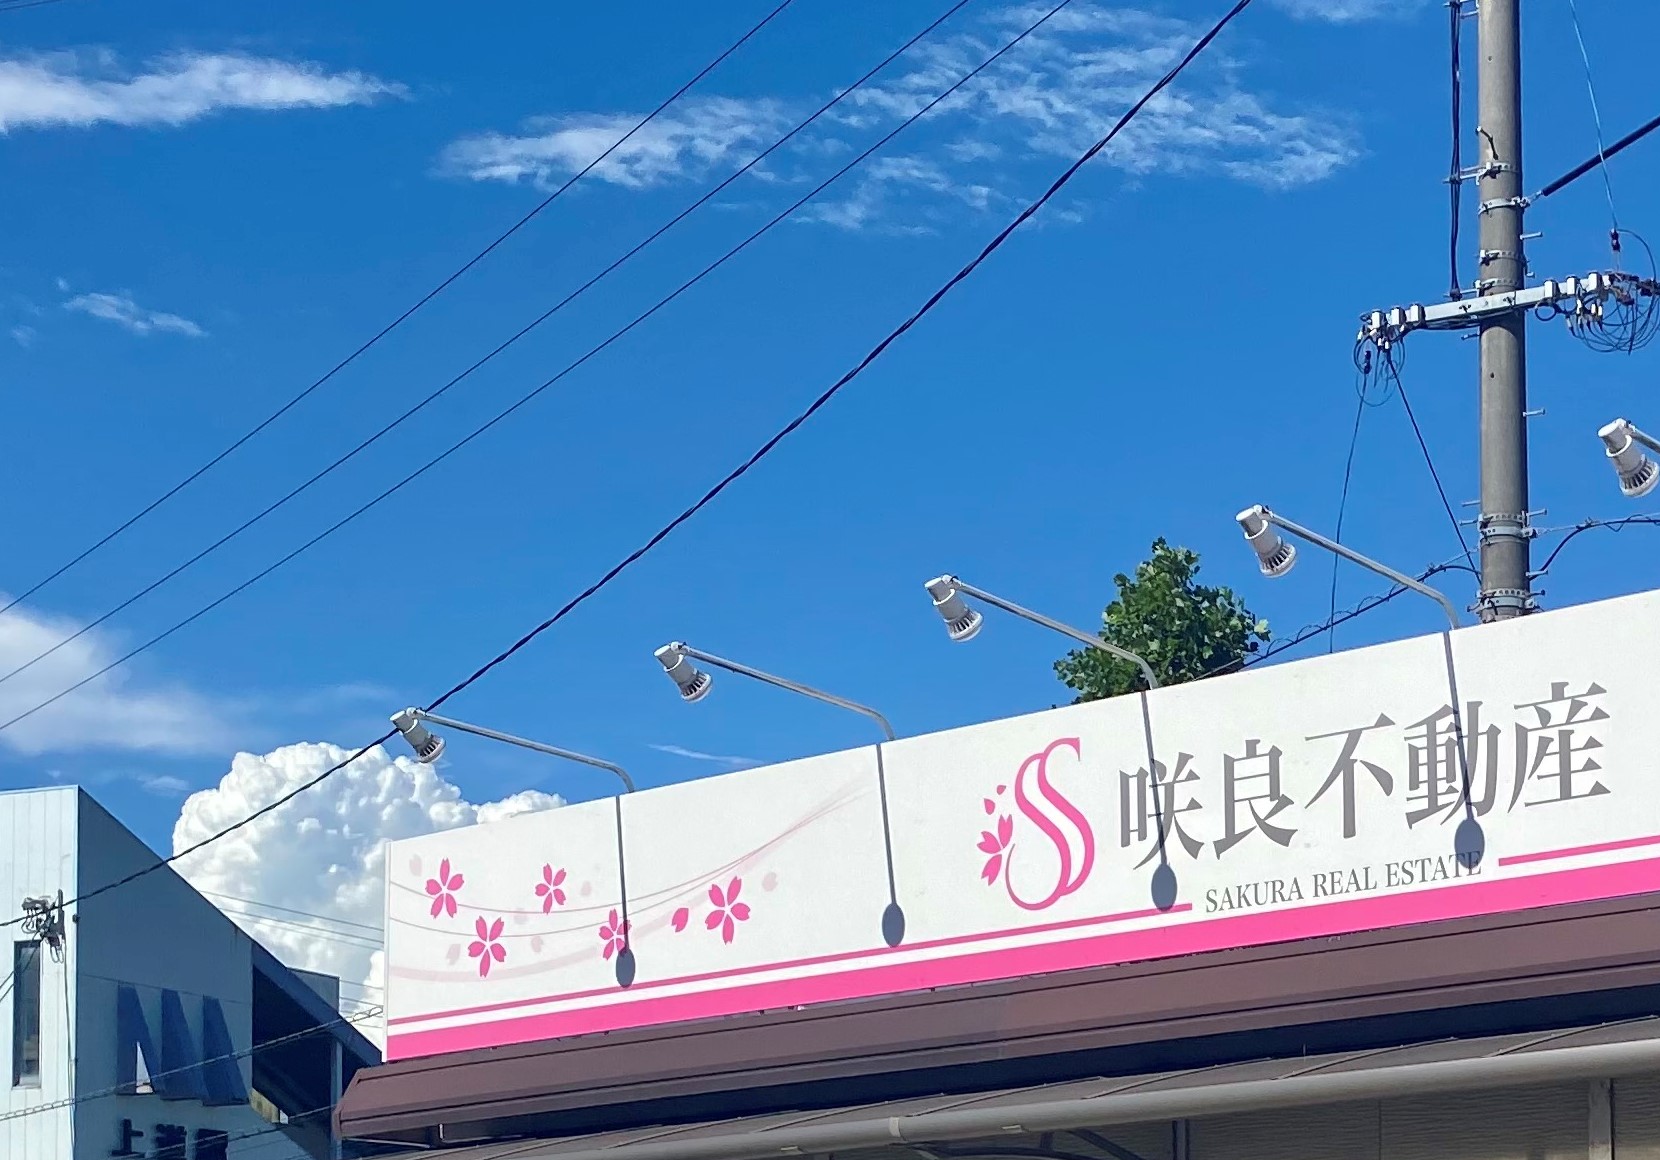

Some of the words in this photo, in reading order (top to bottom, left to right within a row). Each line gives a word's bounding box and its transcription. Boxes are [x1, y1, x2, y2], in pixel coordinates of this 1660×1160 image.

[1118, 681, 1611, 872] 咲良不動産
[1205, 876, 1304, 914] SAKURA
[1312, 866, 1377, 898] REAL
[1385, 851, 1482, 888] ESTATE
